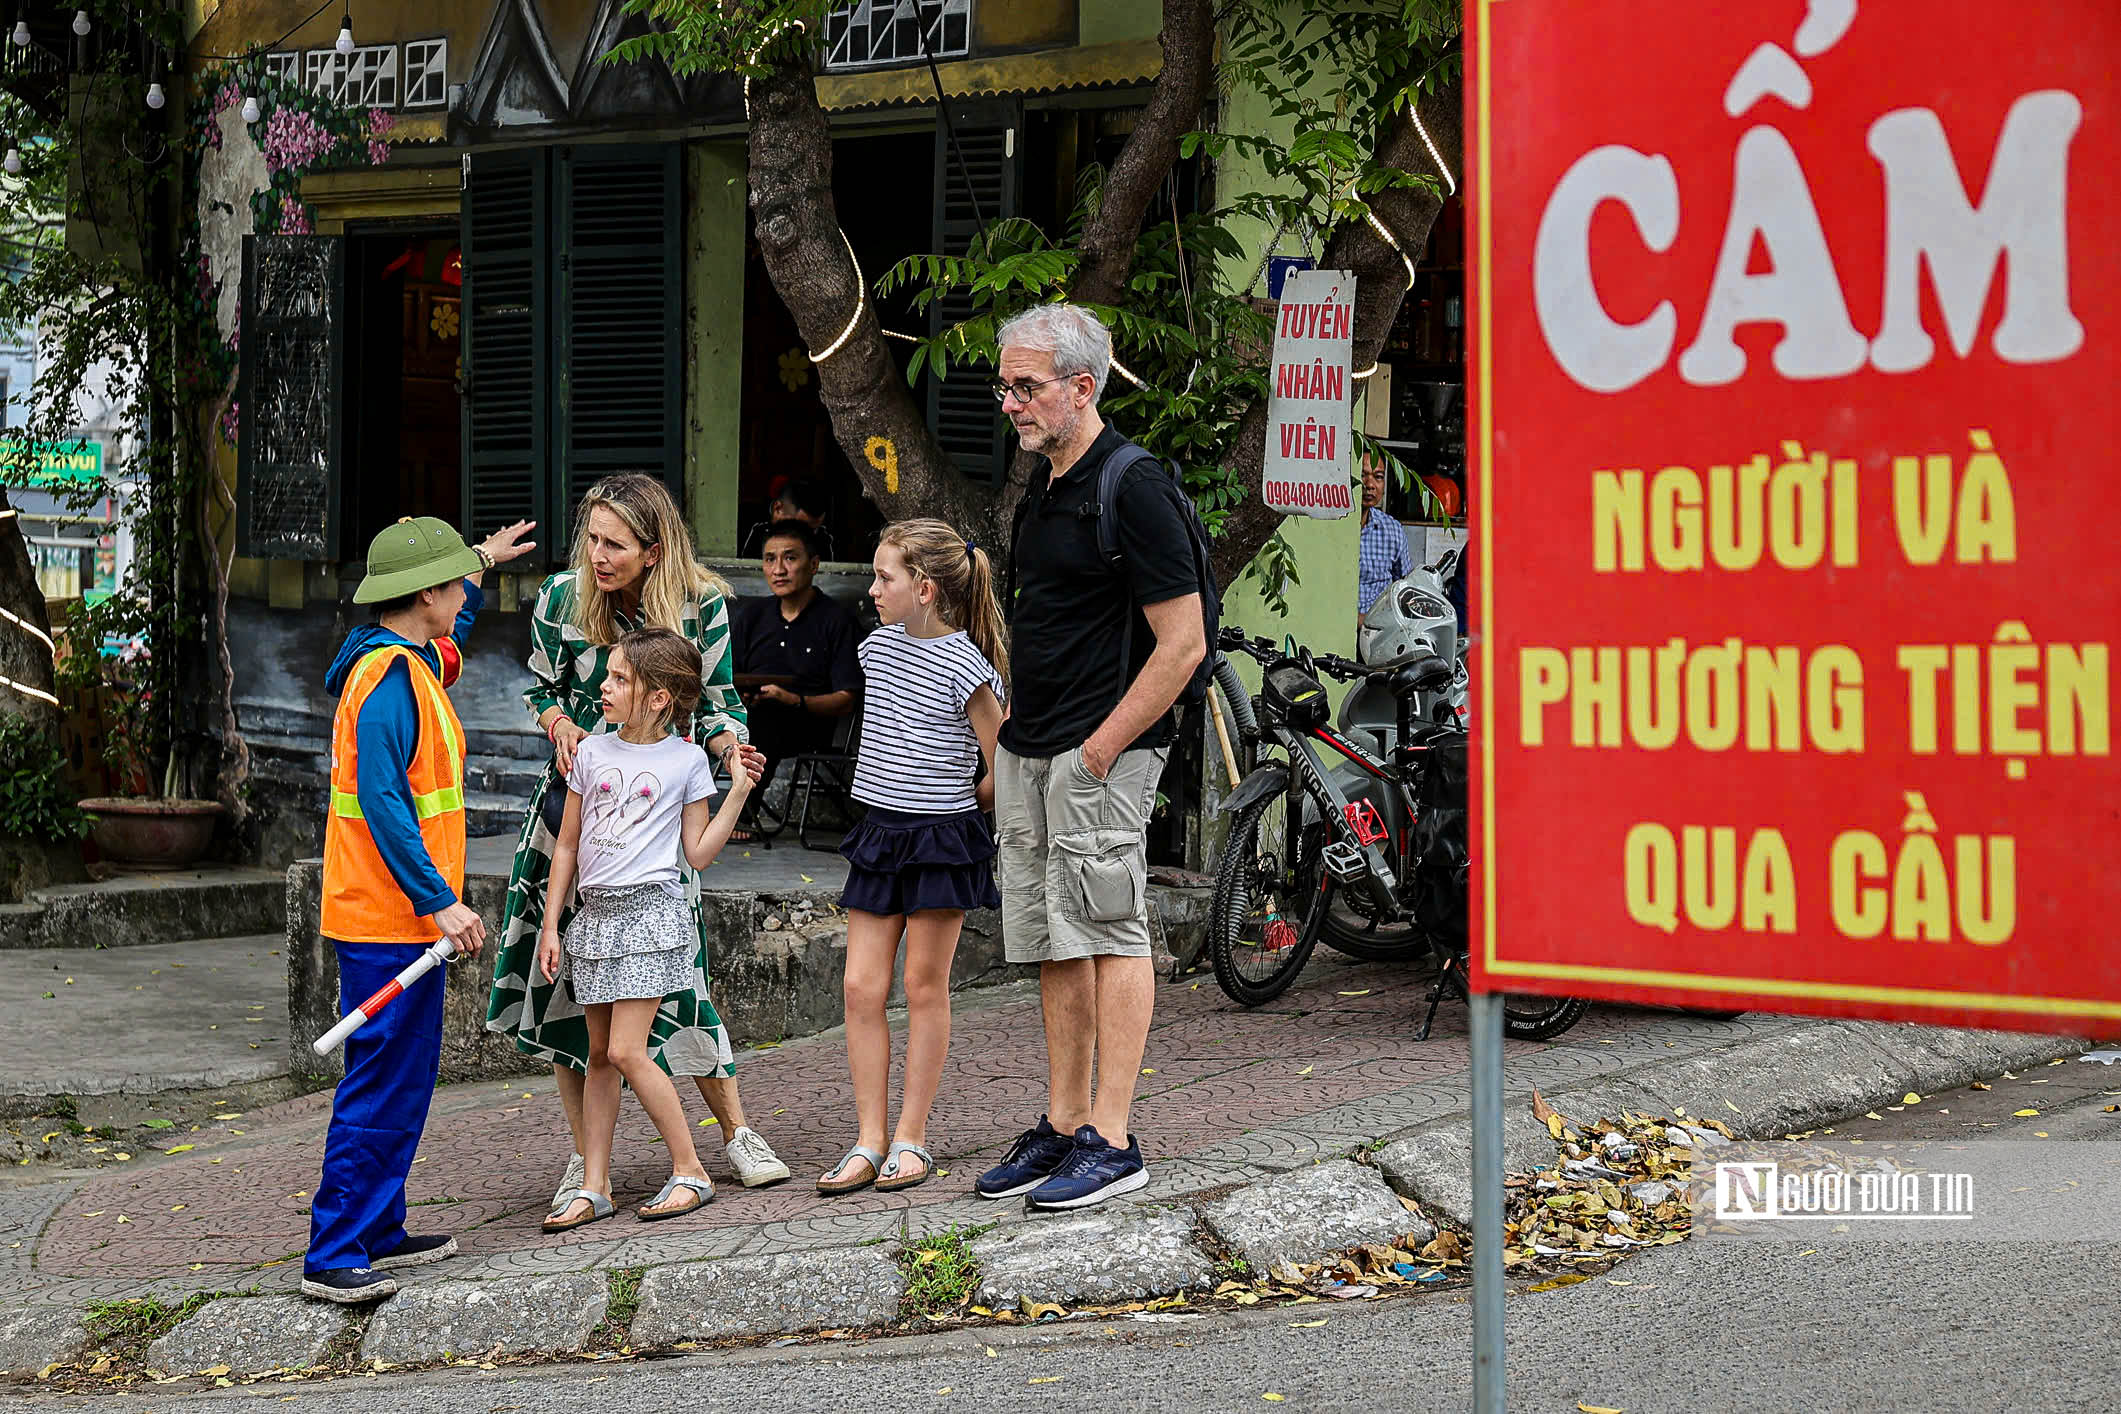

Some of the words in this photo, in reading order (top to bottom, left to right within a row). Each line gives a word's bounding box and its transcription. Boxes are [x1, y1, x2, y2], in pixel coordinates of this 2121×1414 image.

[1280, 286, 1351, 340] TUYỂN
[1276, 358, 1344, 401] NHÂN
[863, 435, 899, 494] 9
[1280, 416, 1336, 461] VIÊN
[1265, 480, 1351, 509] 0984804000
[1592, 439, 1858, 572] NGƯỜI
[1892, 428, 2017, 565] VÀ
[1519, 637, 1865, 754] PHƯƠNG
[1897, 620, 2110, 779] TIỆN
[1623, 821, 1798, 935] QUA
[1829, 790, 2017, 946] CẦU
